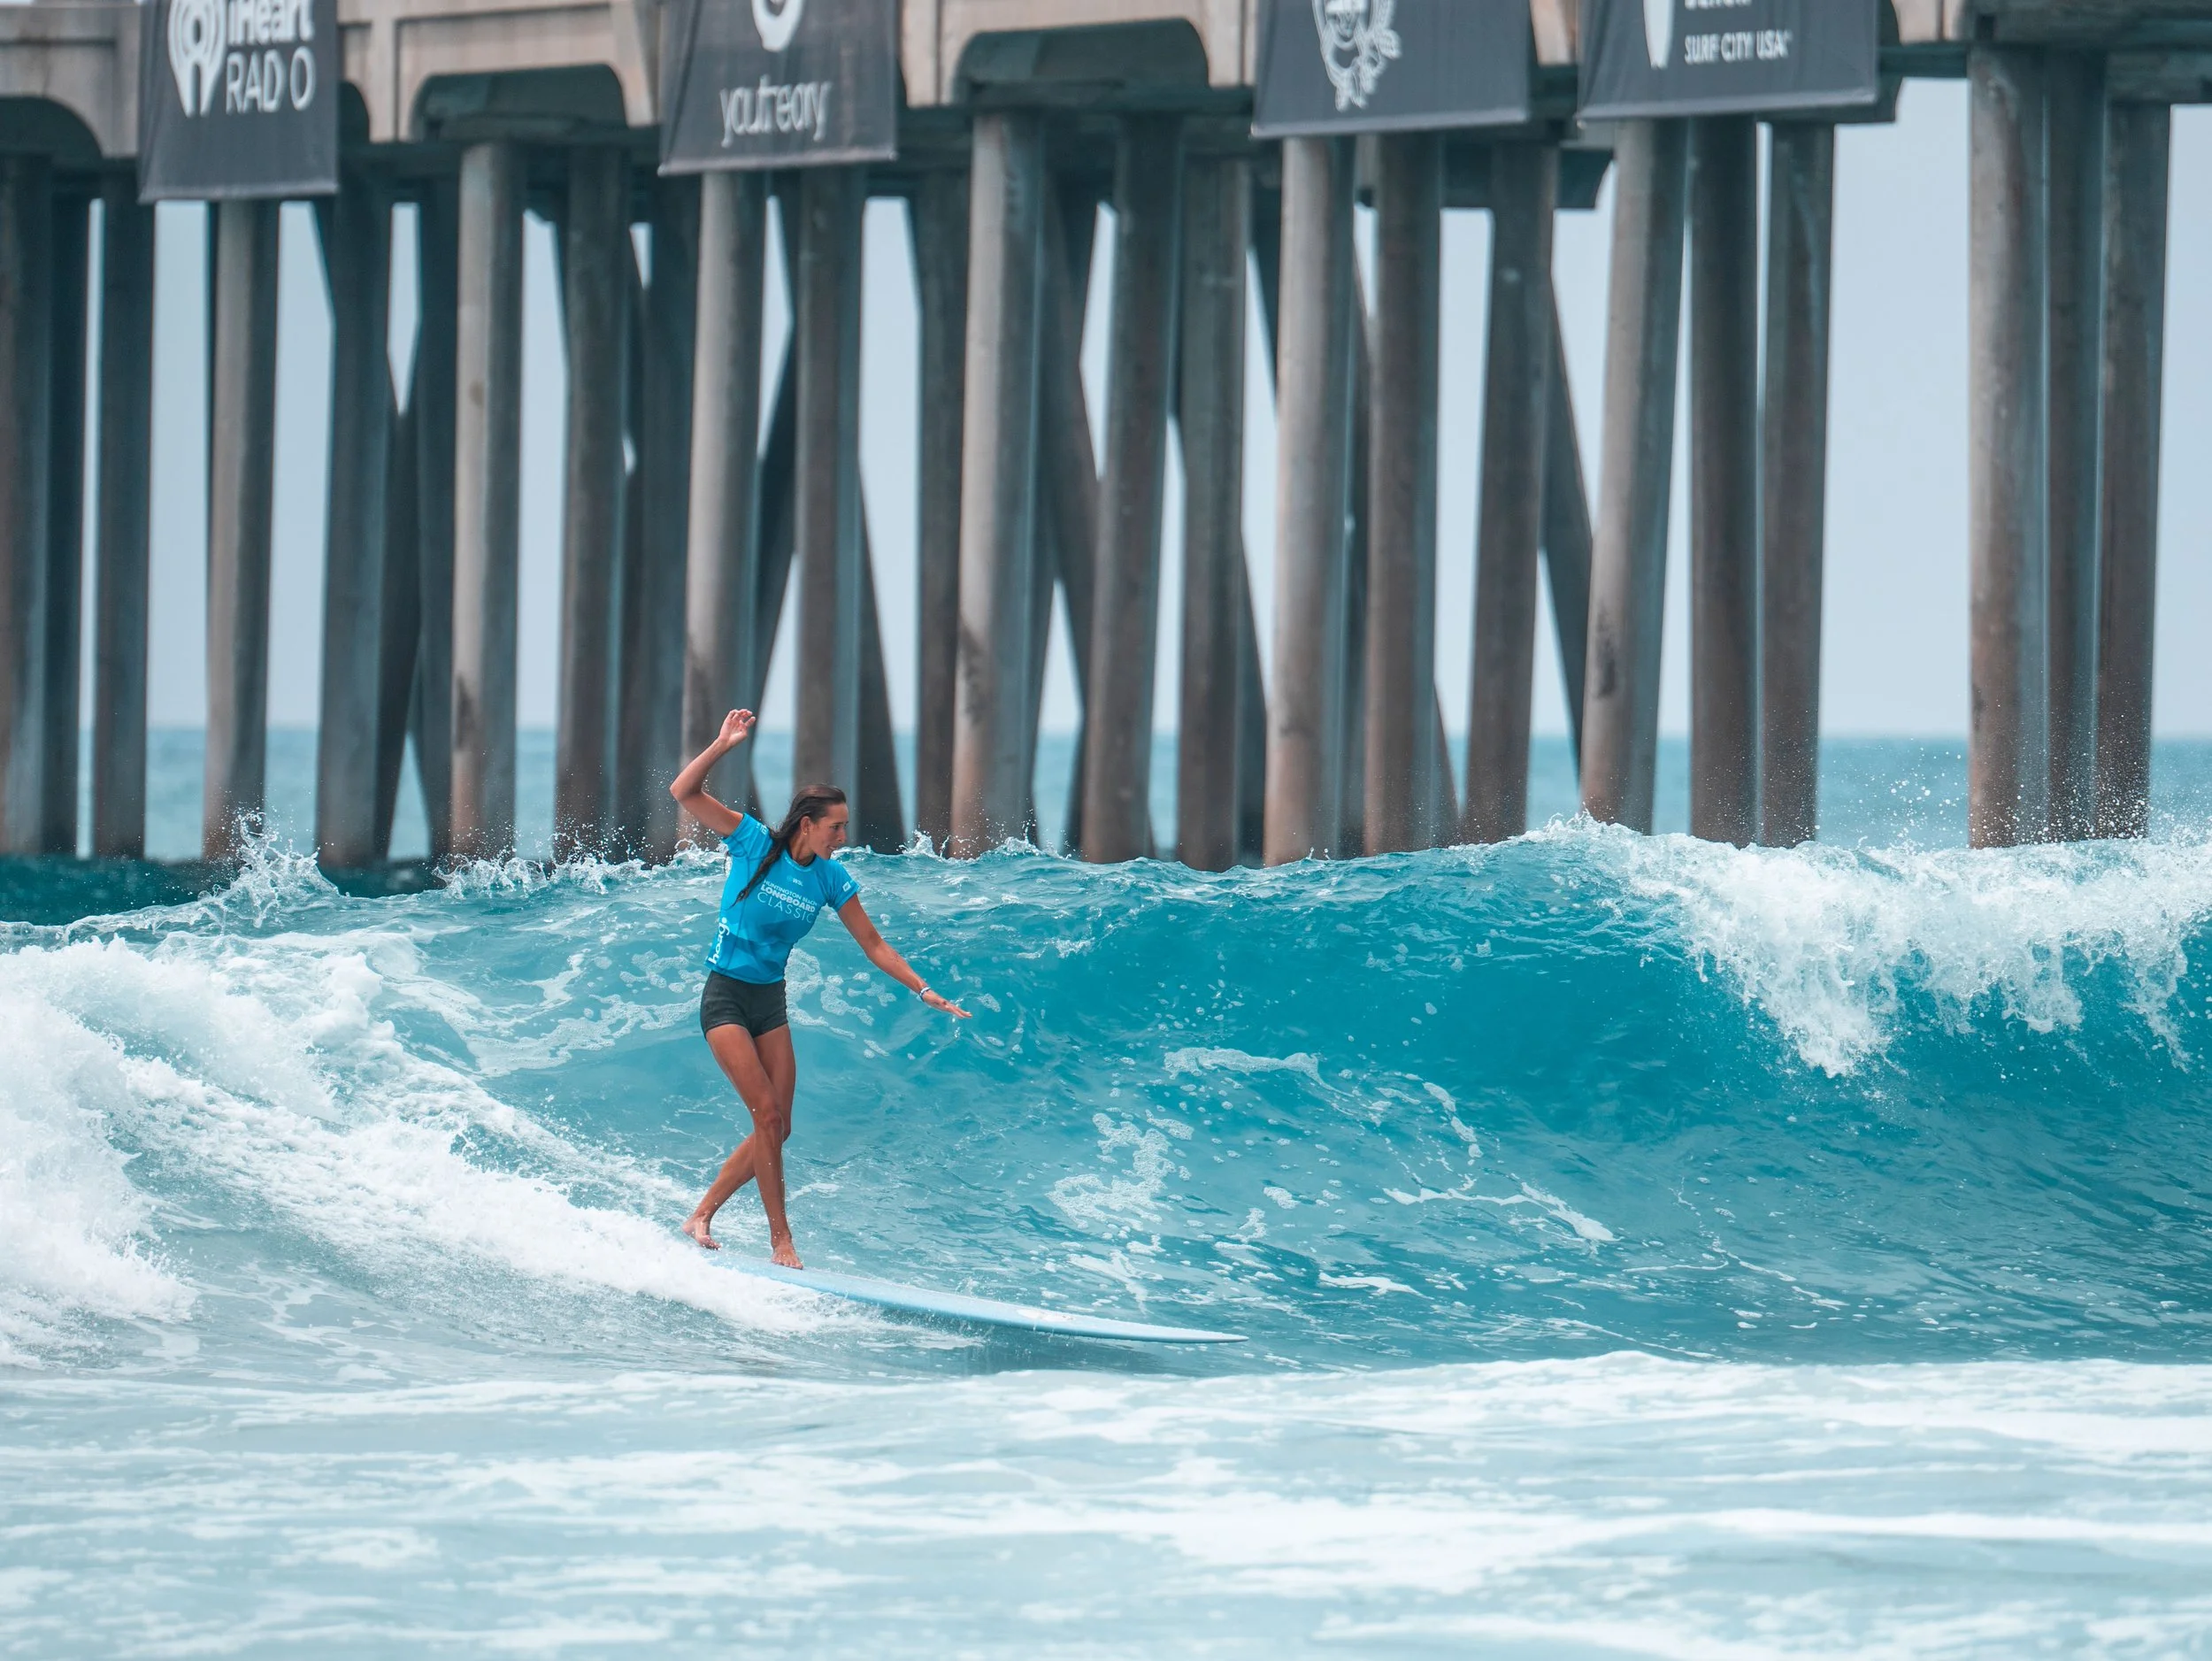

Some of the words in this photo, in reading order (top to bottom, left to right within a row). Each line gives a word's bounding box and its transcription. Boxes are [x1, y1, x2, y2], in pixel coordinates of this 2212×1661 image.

[1685, 34, 1720, 65] SURF
[1721, 32, 1754, 63] CITY
[226, 46, 316, 115] RADO
[761, 884, 815, 912] LONGBOARD
[764, 880, 802, 900] HUNTINGTON
[757, 892, 814, 923] CLASSIC
